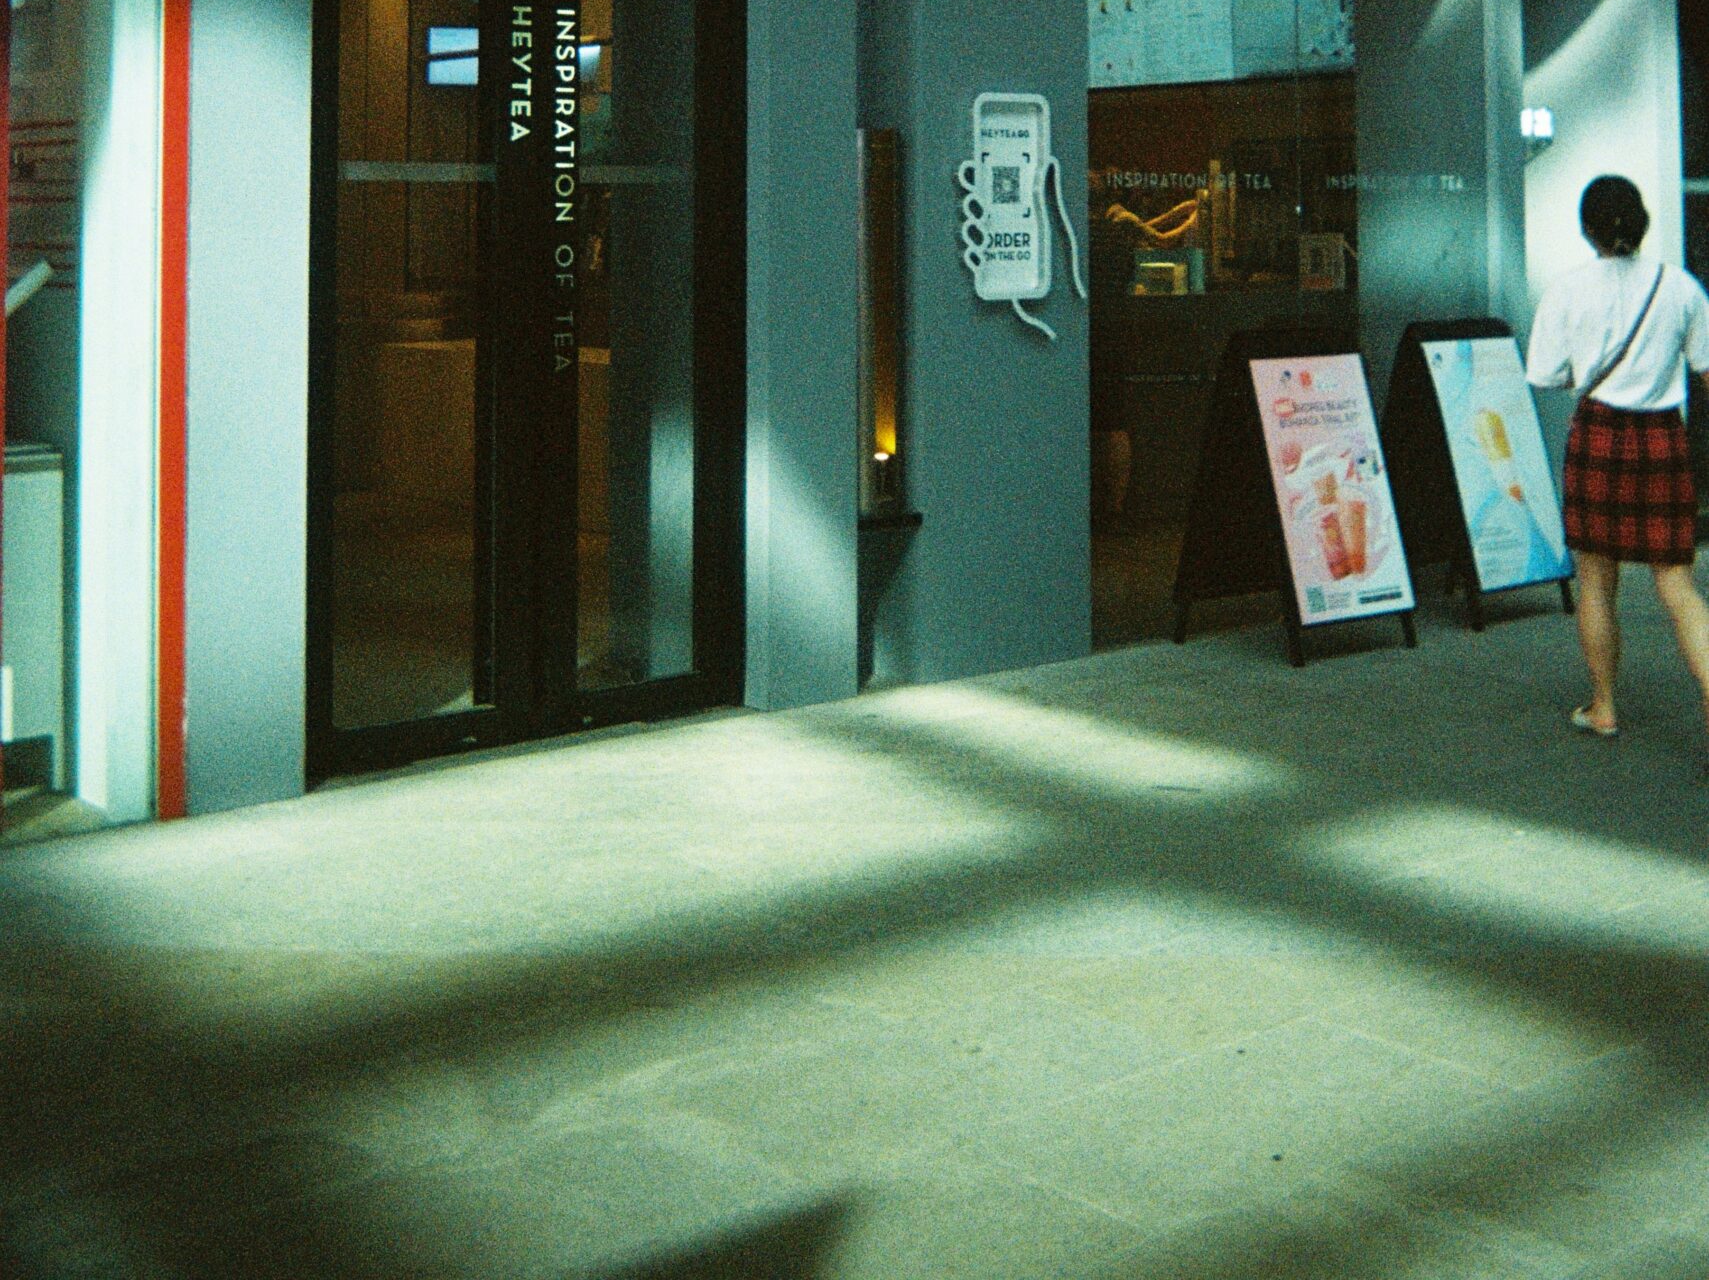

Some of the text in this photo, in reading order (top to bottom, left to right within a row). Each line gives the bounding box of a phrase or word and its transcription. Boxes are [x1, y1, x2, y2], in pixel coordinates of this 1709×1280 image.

[511, 5, 532, 142] HEYTEA
[553, 9, 576, 372] INSPIRATION OF TEA
[1106, 171, 1207, 189] INSPIRATION
[1244, 173, 1272, 189] TEA
